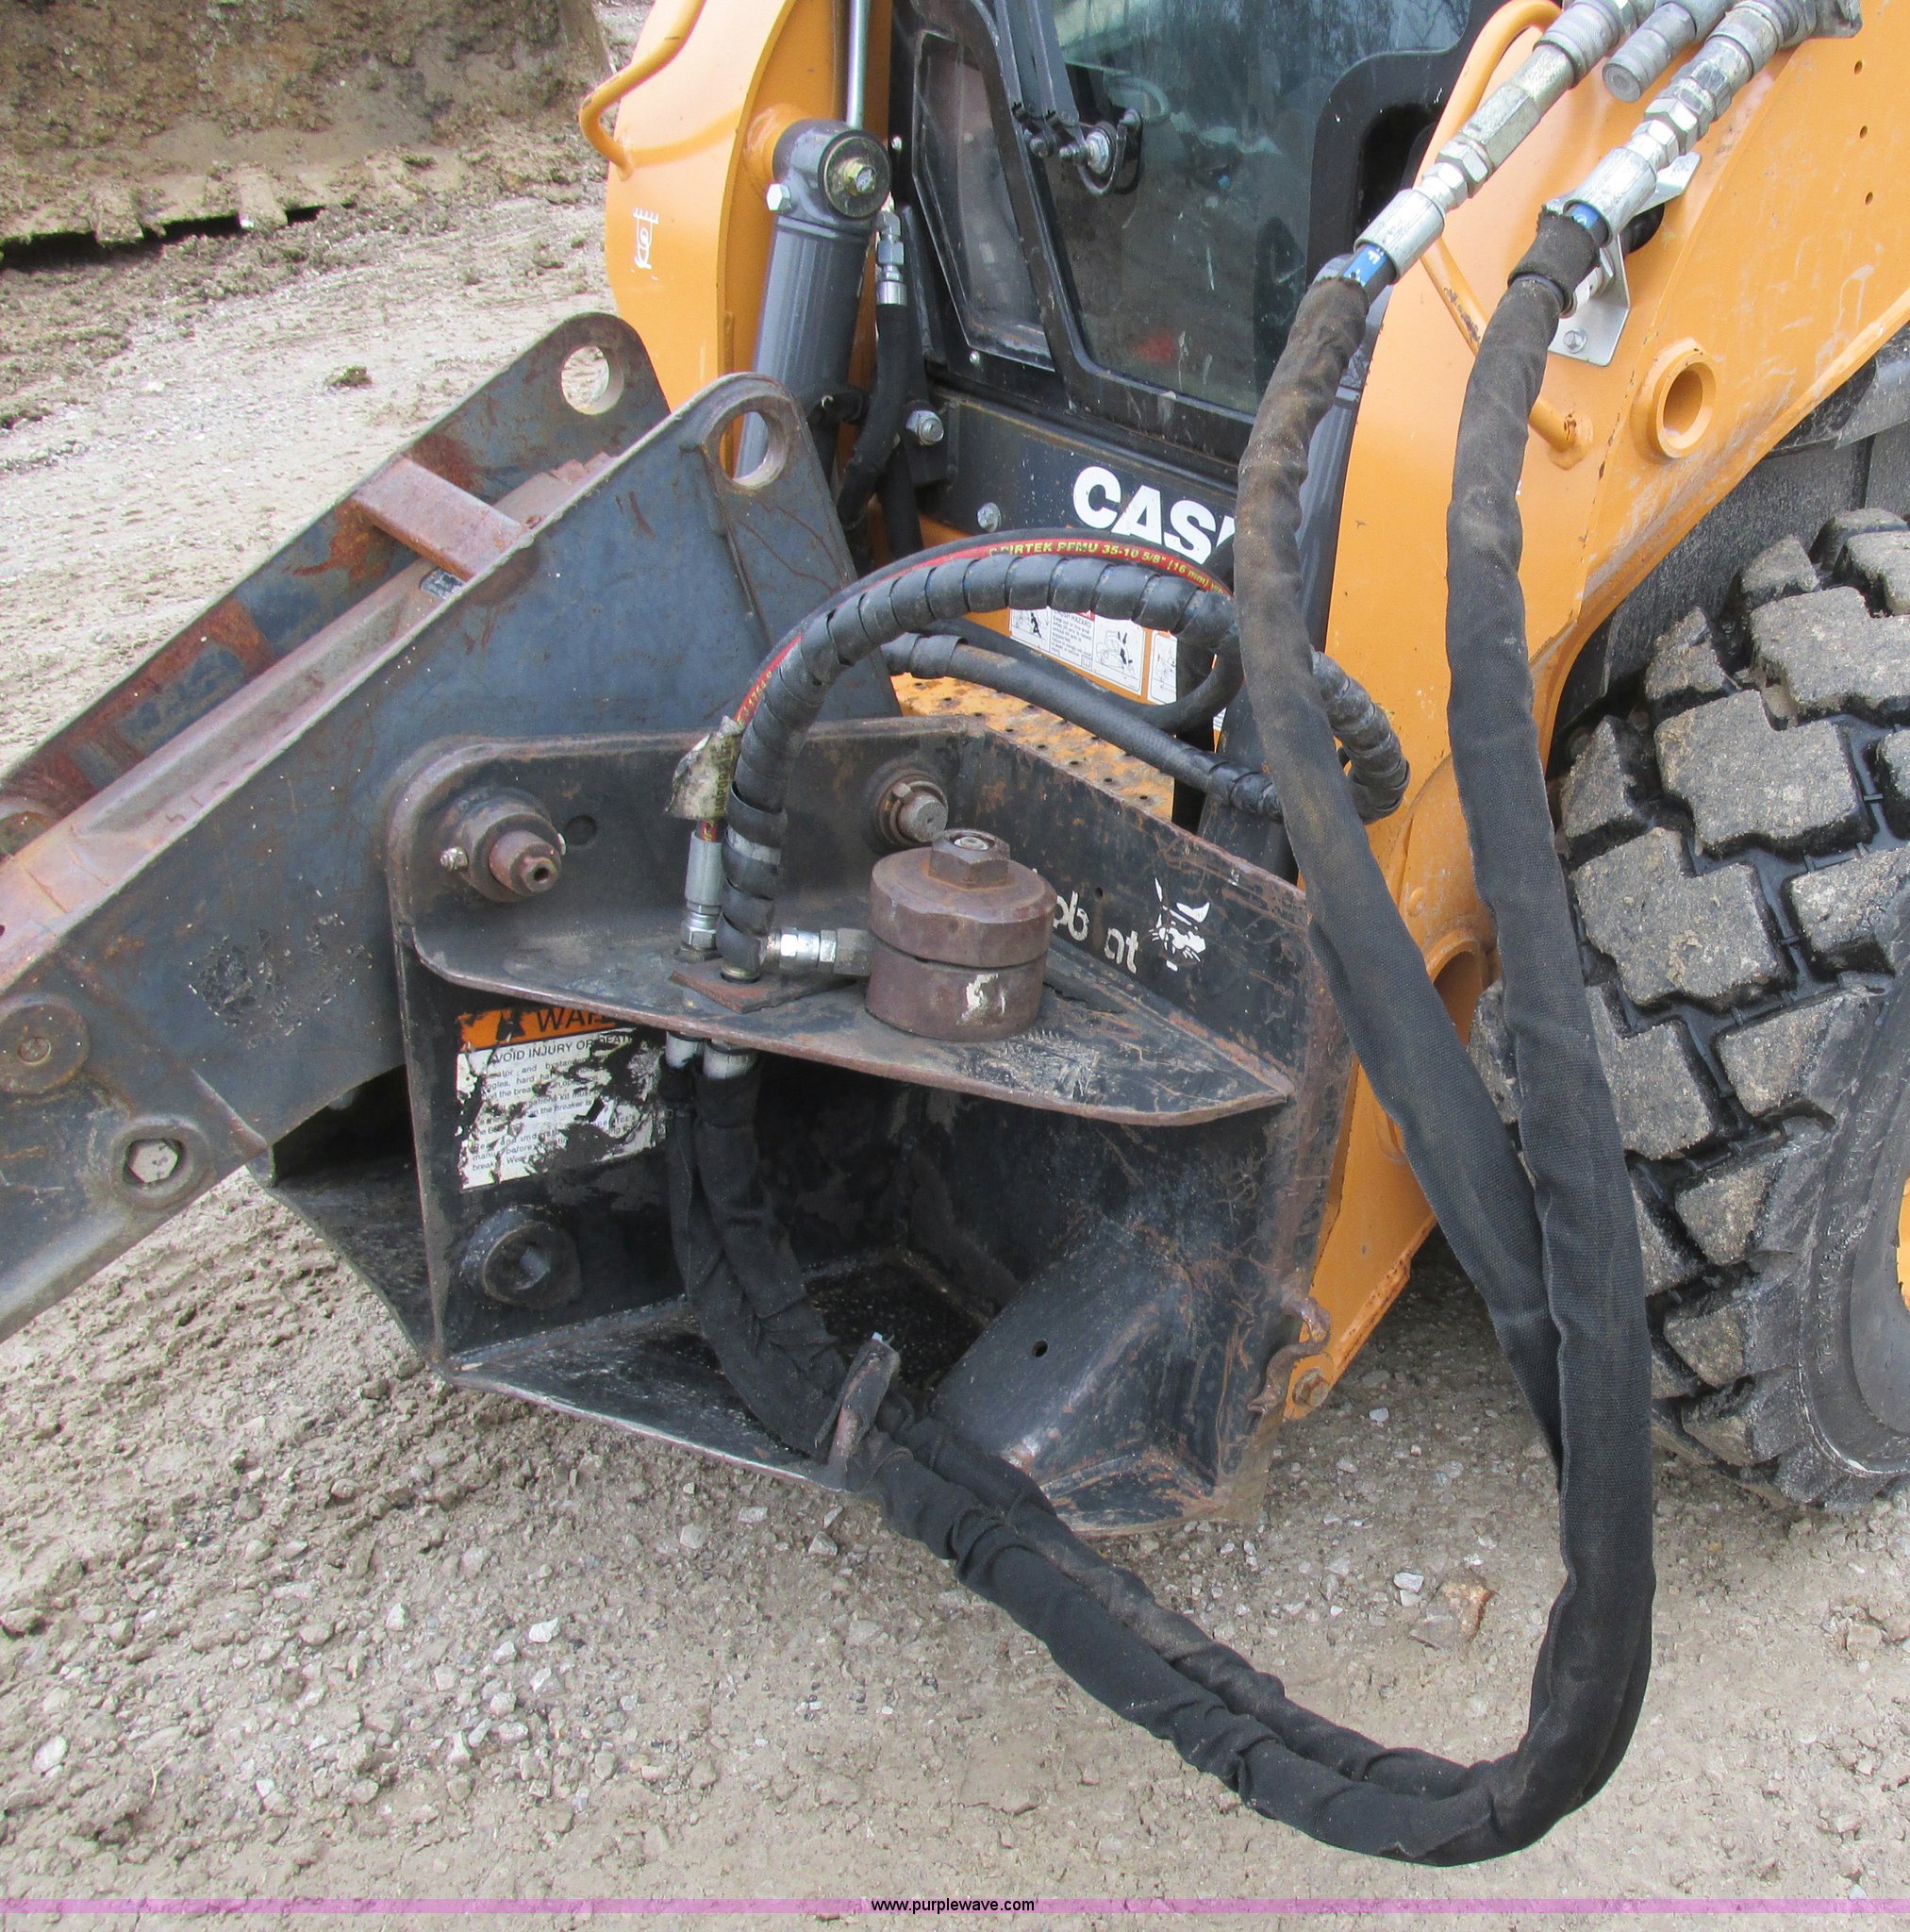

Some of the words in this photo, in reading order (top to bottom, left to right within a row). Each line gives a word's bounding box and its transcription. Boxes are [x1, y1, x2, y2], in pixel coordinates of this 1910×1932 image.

[1102, 544, 1139, 558] 35-10
[1141, 551, 1167, 564] 5/8"
[528, 1042, 573, 1058] INJURY
[522, 1063, 538, 1074] and
[516, 1075, 535, 1085] hard
[554, 1100, 583, 1112] breaker
[506, 1143, 533, 1155] before
